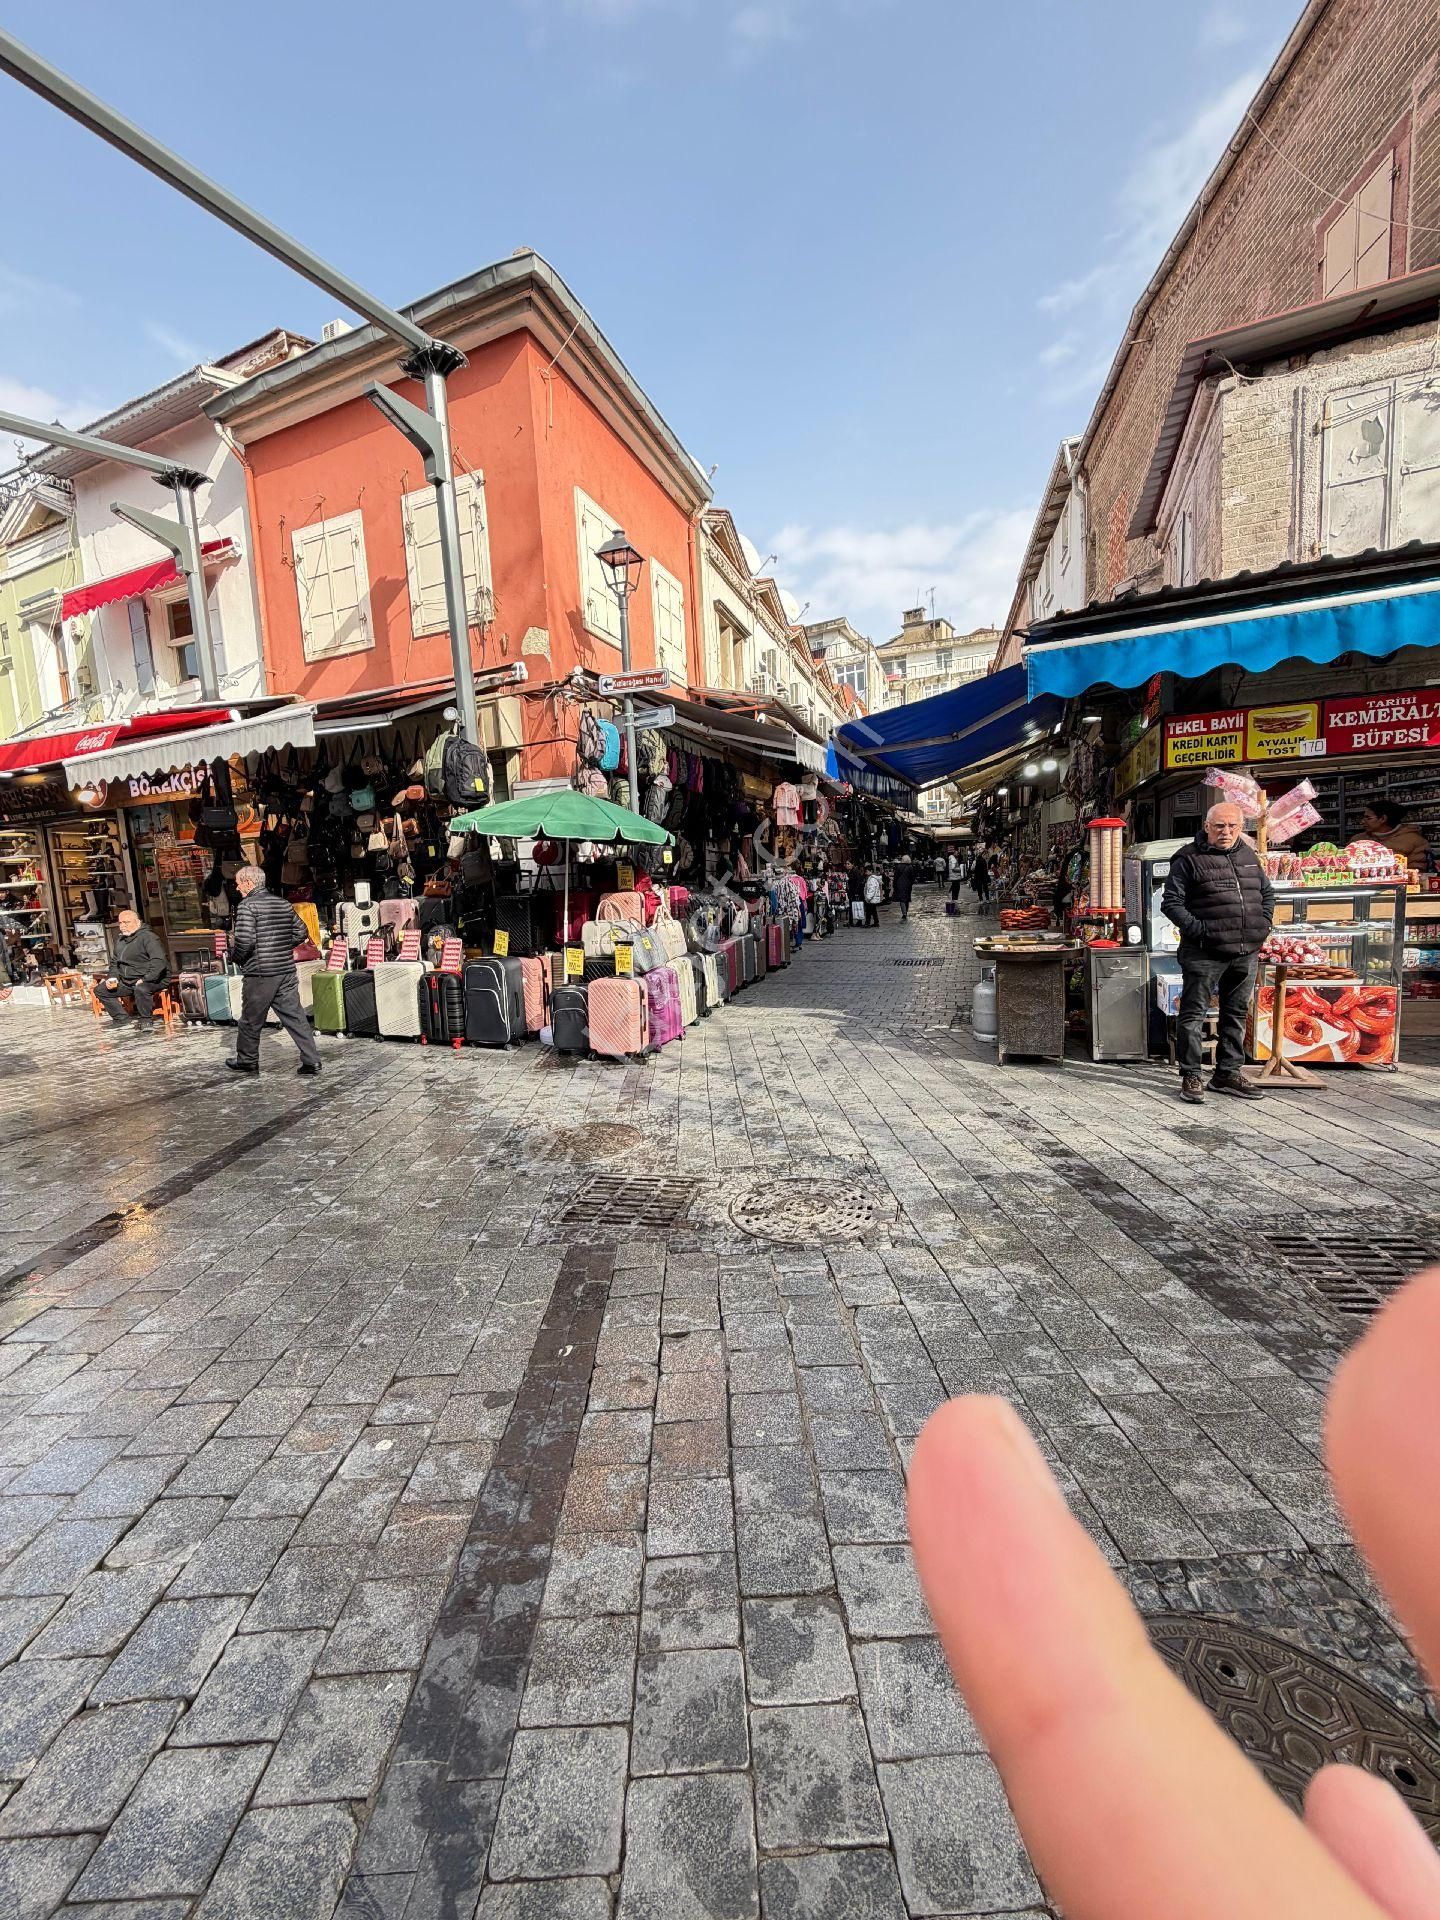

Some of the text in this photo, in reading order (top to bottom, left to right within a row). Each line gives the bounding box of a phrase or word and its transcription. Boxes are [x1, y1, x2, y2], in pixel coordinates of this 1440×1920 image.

[1366, 694, 1417, 709] TARİHİ
[1167, 719, 1208, 735] TEKEL
[1172, 735, 1238, 750] KREDİ KARTI
[1257, 736, 1306, 748] AYVALIK
[1351, 723, 1430, 748] BÜFESİ
[1267, 747, 1297, 756] TOST
[1302, 741, 1324, 754] 170
[1174, 748, 1236, 765] GEÇERLİDİR
